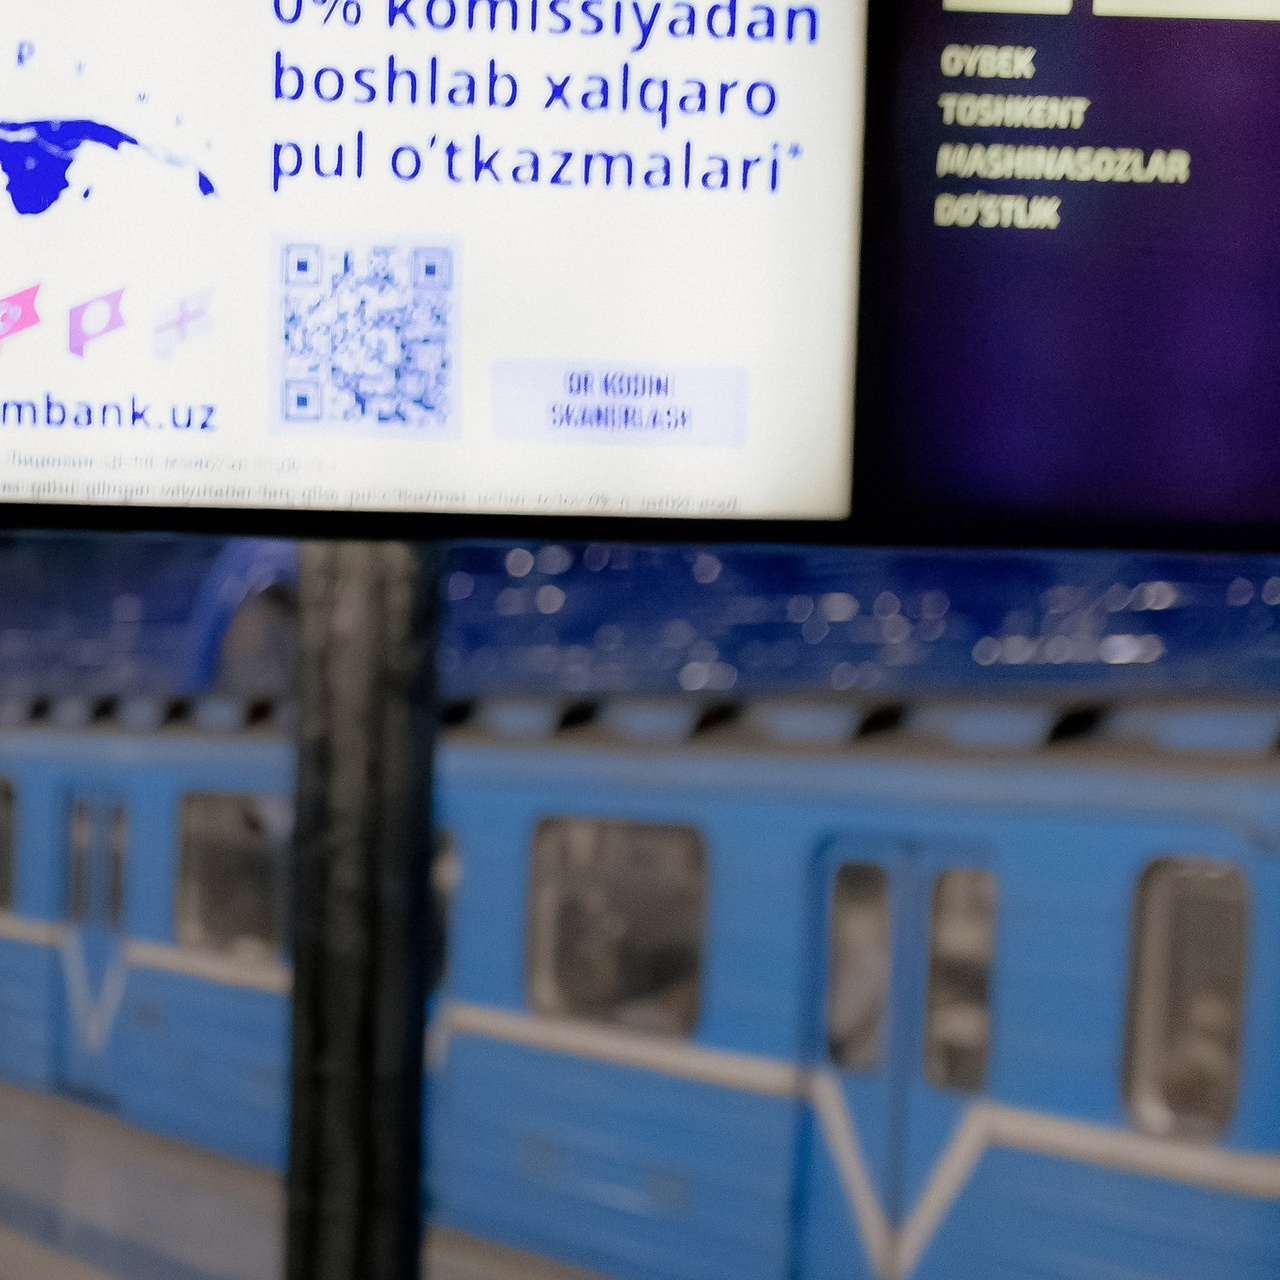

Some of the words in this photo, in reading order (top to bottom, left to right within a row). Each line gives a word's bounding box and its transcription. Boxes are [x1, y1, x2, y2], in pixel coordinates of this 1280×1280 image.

[388, 0, 819, 53] komissiyadan
[274, 50, 518, 108] boshlab
[544, 62, 777, 129] xalqaro
[941, 45, 1036, 79] OYBEK
[273, 130, 364, 192] pul
